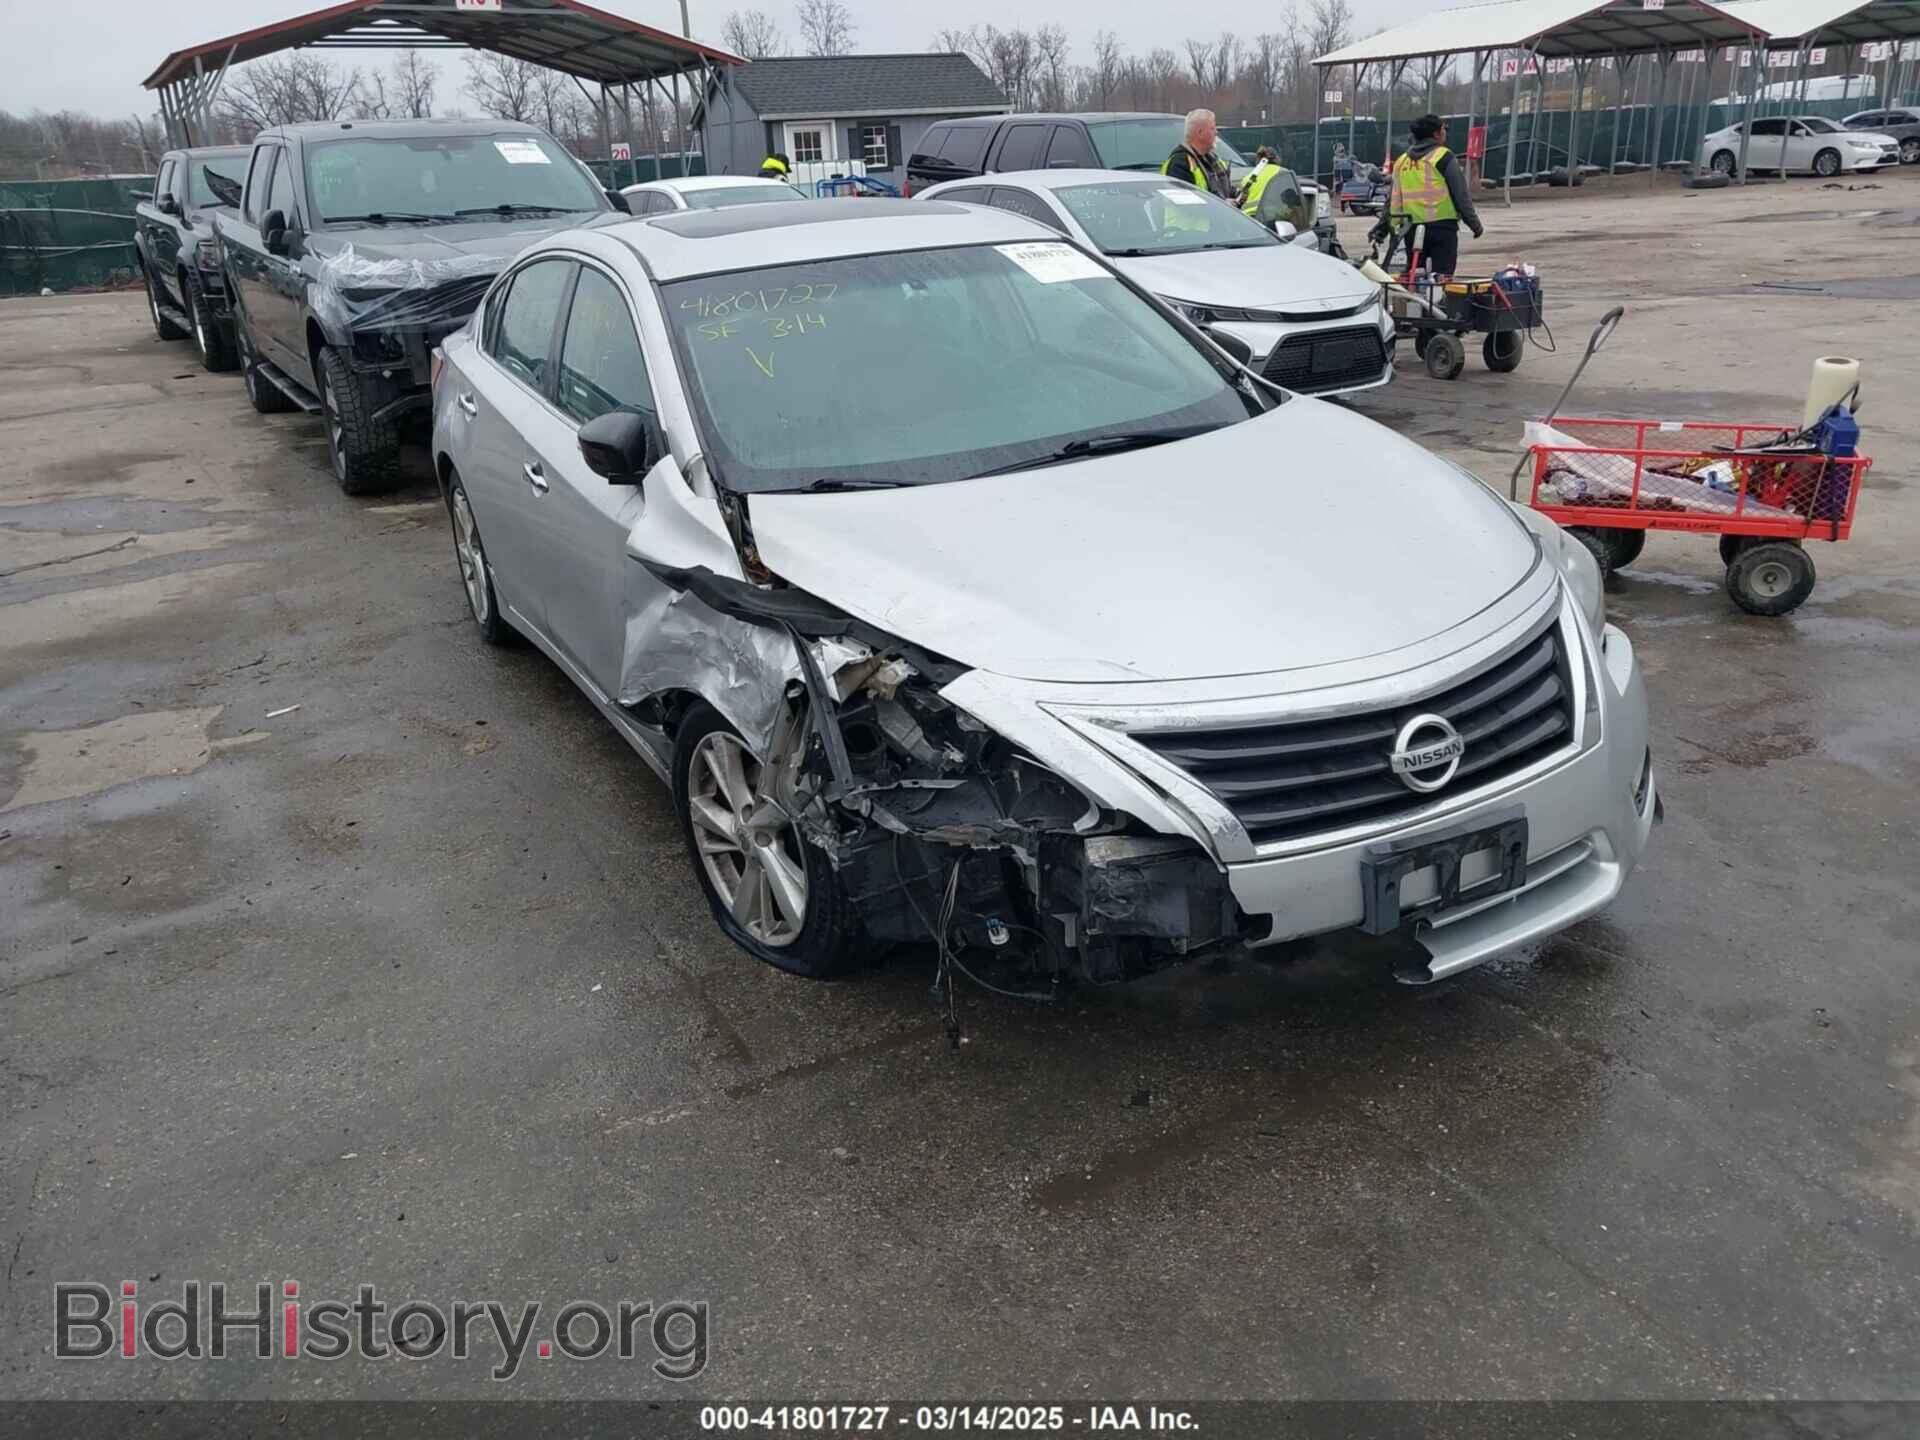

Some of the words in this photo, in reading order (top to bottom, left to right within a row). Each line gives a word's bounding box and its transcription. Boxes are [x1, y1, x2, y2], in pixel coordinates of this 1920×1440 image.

[1506, 61, 1516, 73] N
[681, 284, 837, 317] 41801727
[1404, 743, 1460, 768] NISSAN
